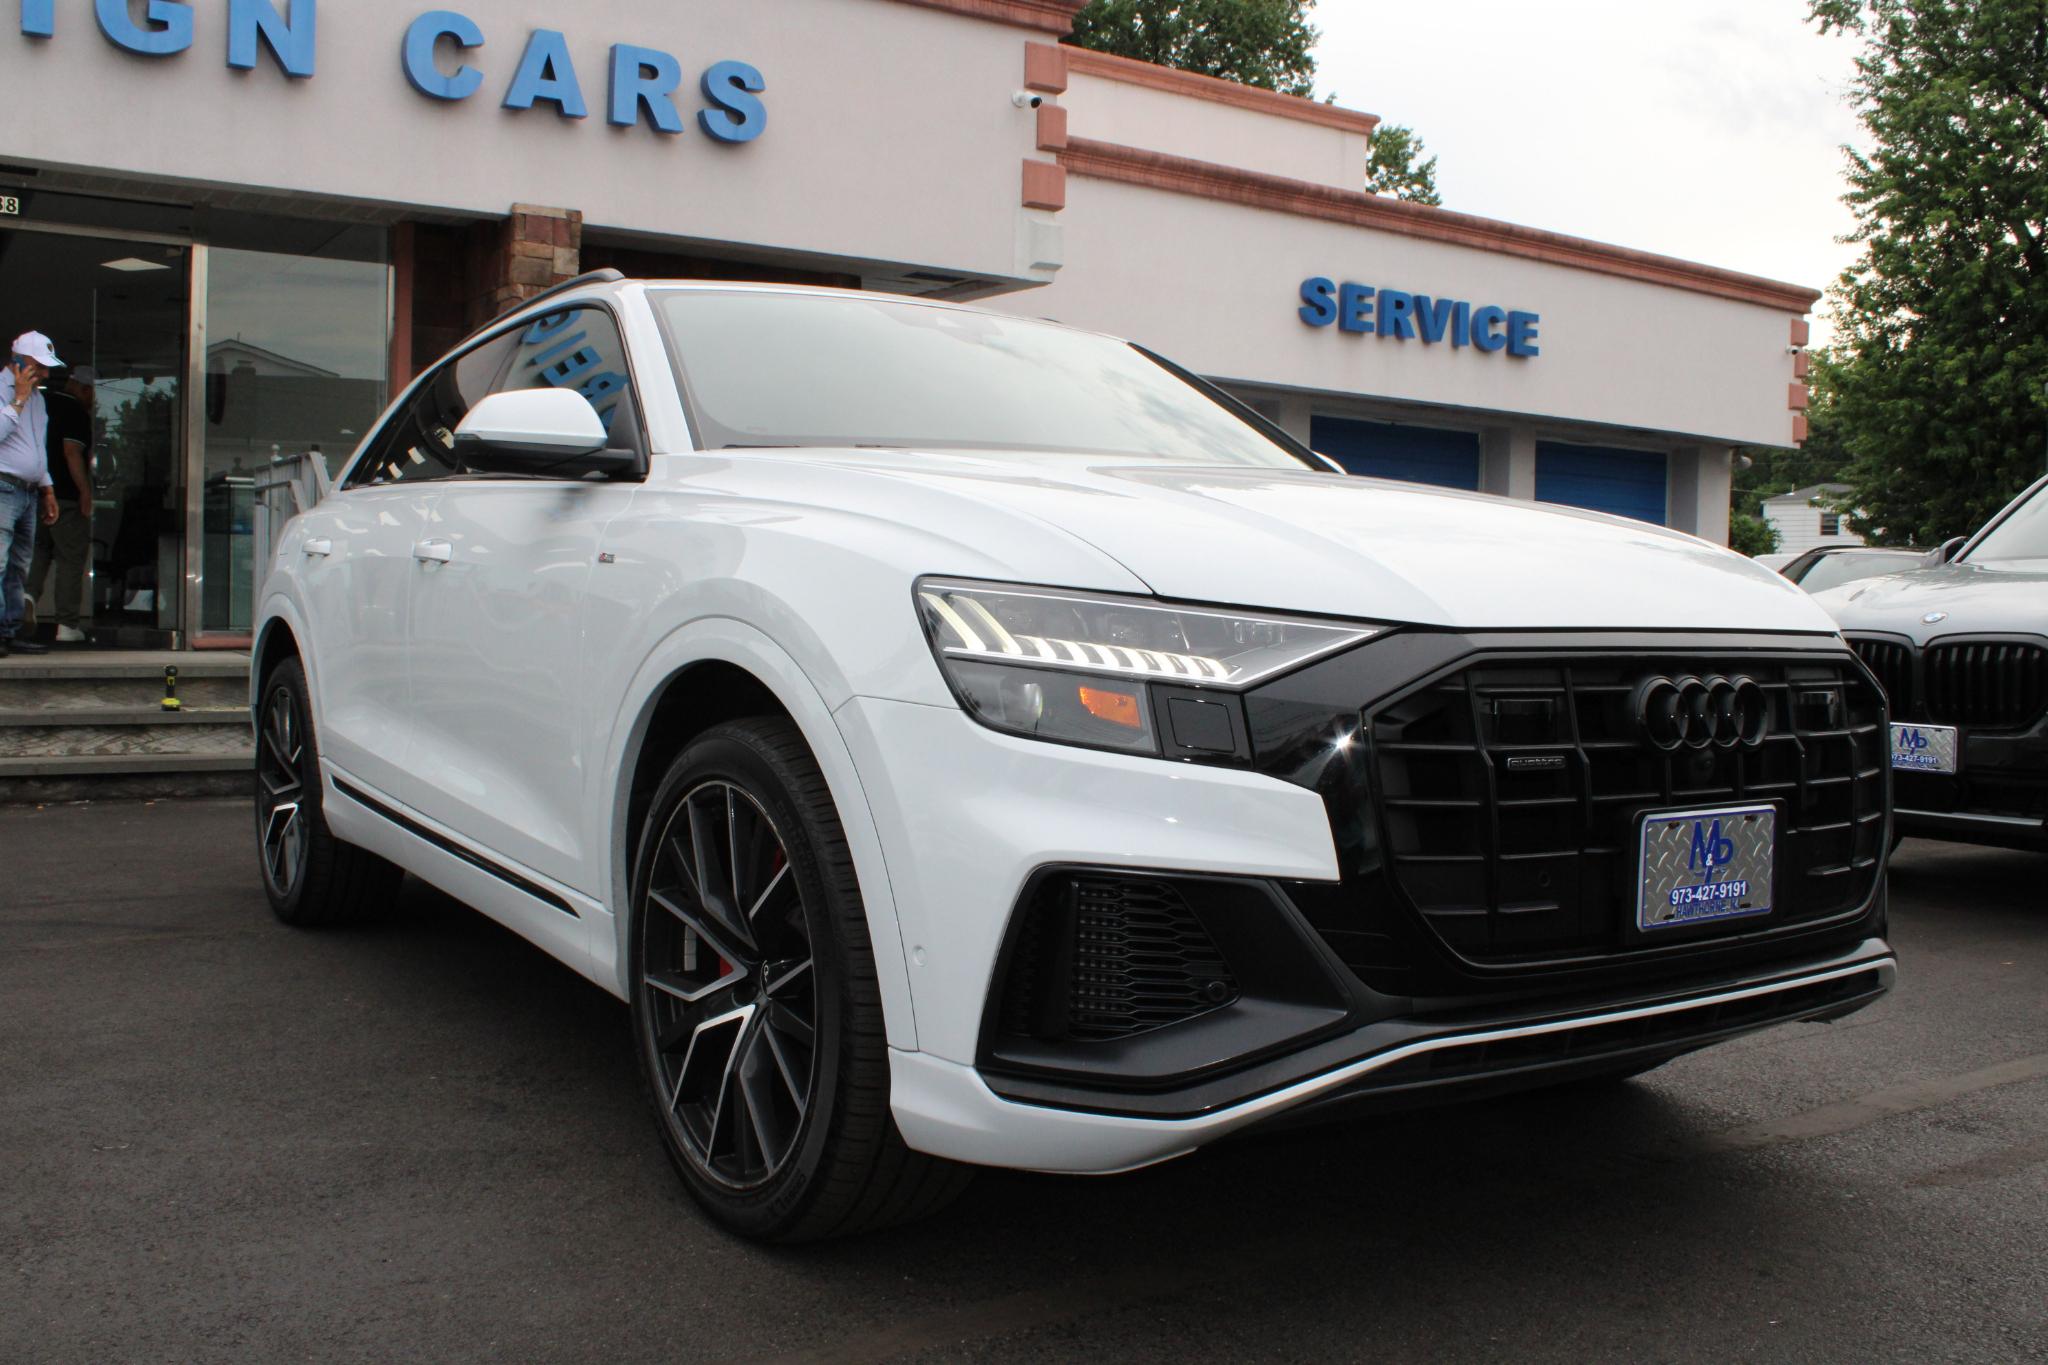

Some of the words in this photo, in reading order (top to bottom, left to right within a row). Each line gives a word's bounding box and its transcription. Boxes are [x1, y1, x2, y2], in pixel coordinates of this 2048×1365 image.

[402, 10, 767, 143] CARS
[1298, 277, 1539, 357] SERVICE
[1671, 881, 1747, 905] 973-427-9191
